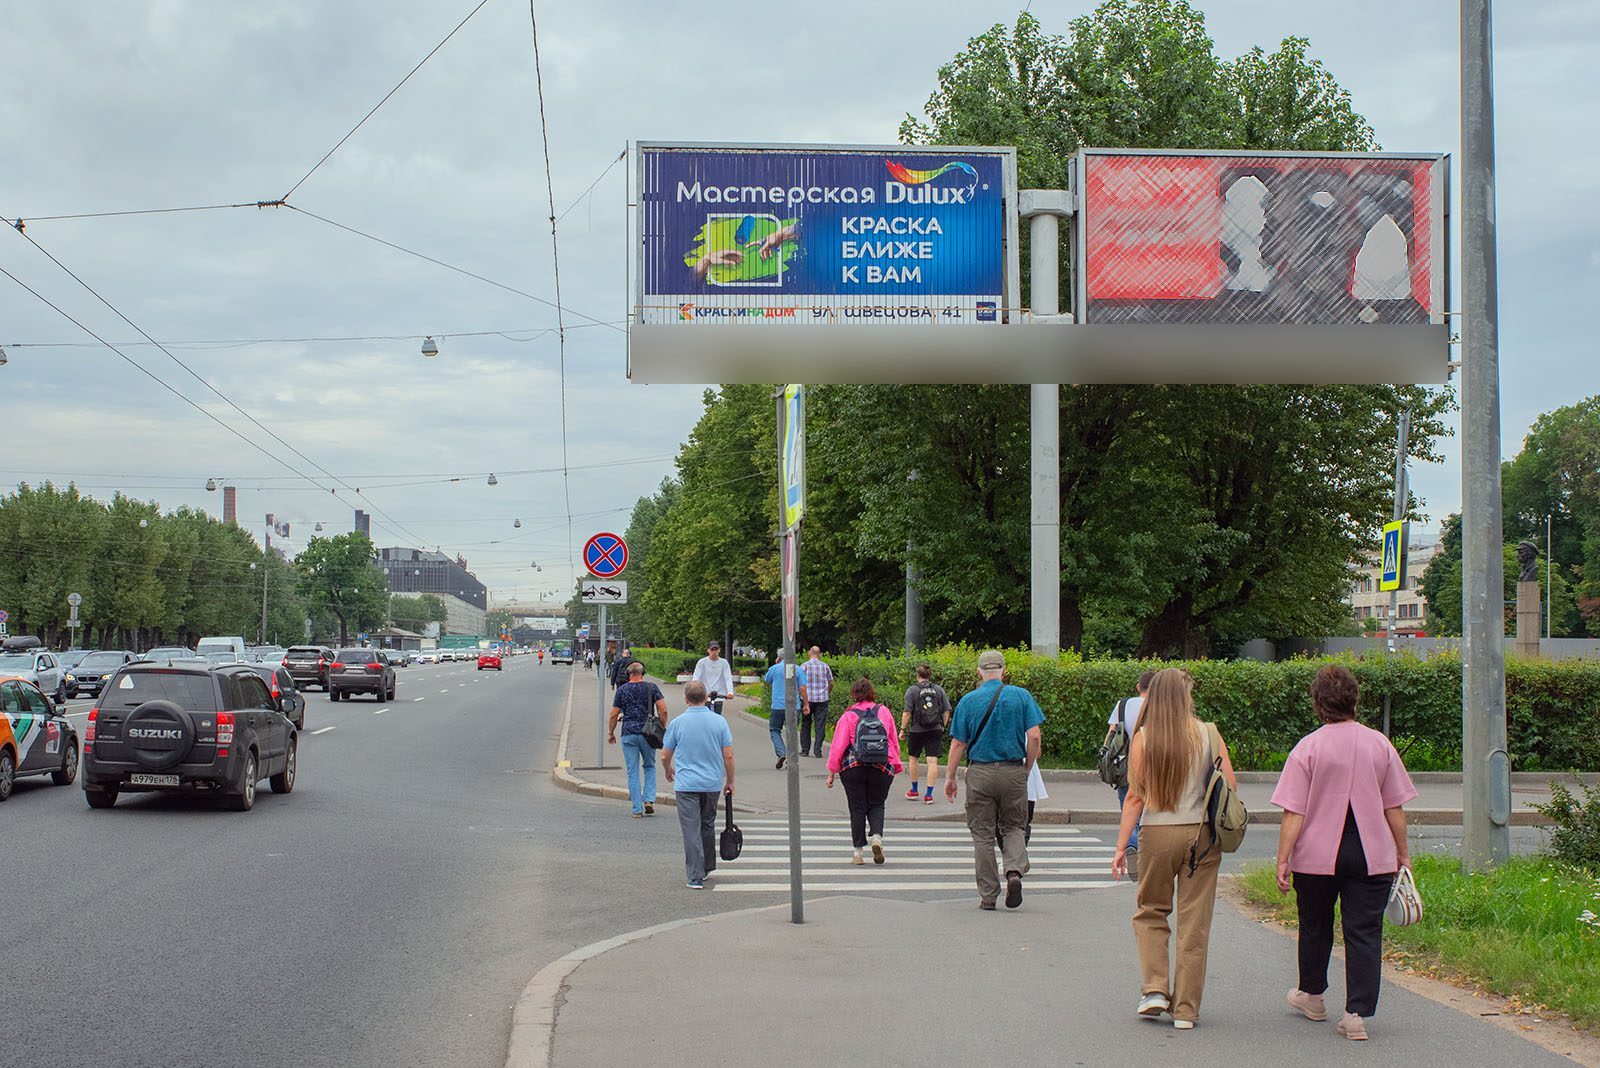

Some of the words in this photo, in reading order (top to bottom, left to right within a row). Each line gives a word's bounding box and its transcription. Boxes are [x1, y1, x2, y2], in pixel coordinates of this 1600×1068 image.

[676, 181, 876, 208] Мастерская
[885, 181, 966, 205] Dulux
[842, 216, 943, 235] КРАСКА
[842, 241, 934, 259] БЛИЖЕ
[842, 265, 859, 283] К
[866, 265, 922, 283] ВАМ
[942, 305, 962, 318] 41
[128, 728, 182, 739] SUZUKI
